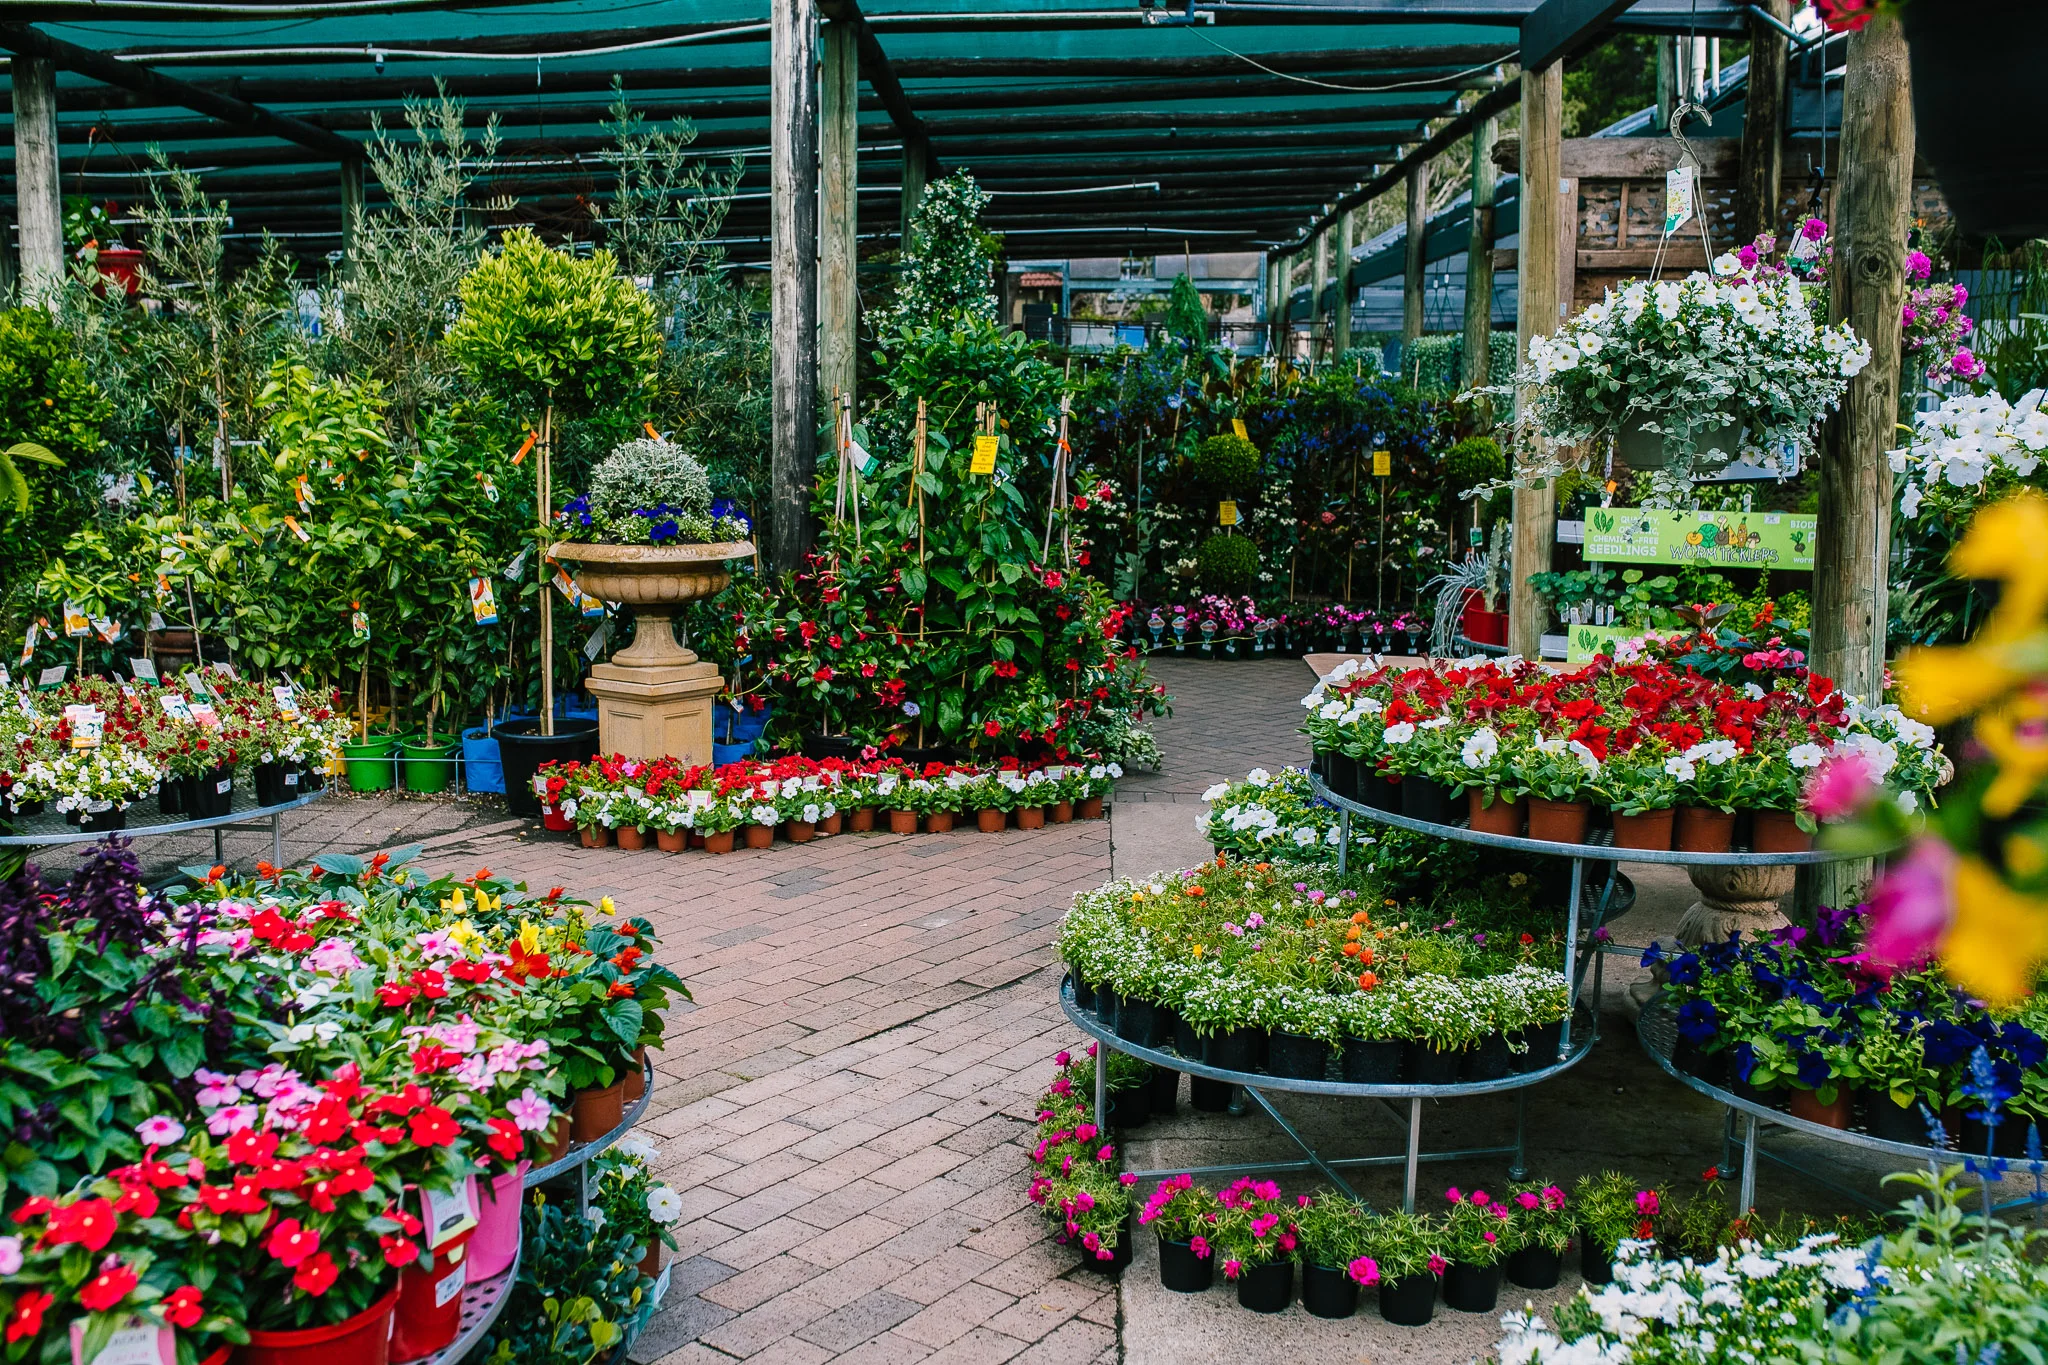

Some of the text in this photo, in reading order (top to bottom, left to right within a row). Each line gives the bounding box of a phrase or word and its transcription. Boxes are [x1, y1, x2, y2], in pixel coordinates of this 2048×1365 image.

[1620, 515, 1660, 526] QUITY,
[1593, 534, 1659, 545] CHEMIC-FREE
[1588, 543, 1657, 557] SEEDLINGS
[1670, 541, 1779, 563] WORM TICKLERS
